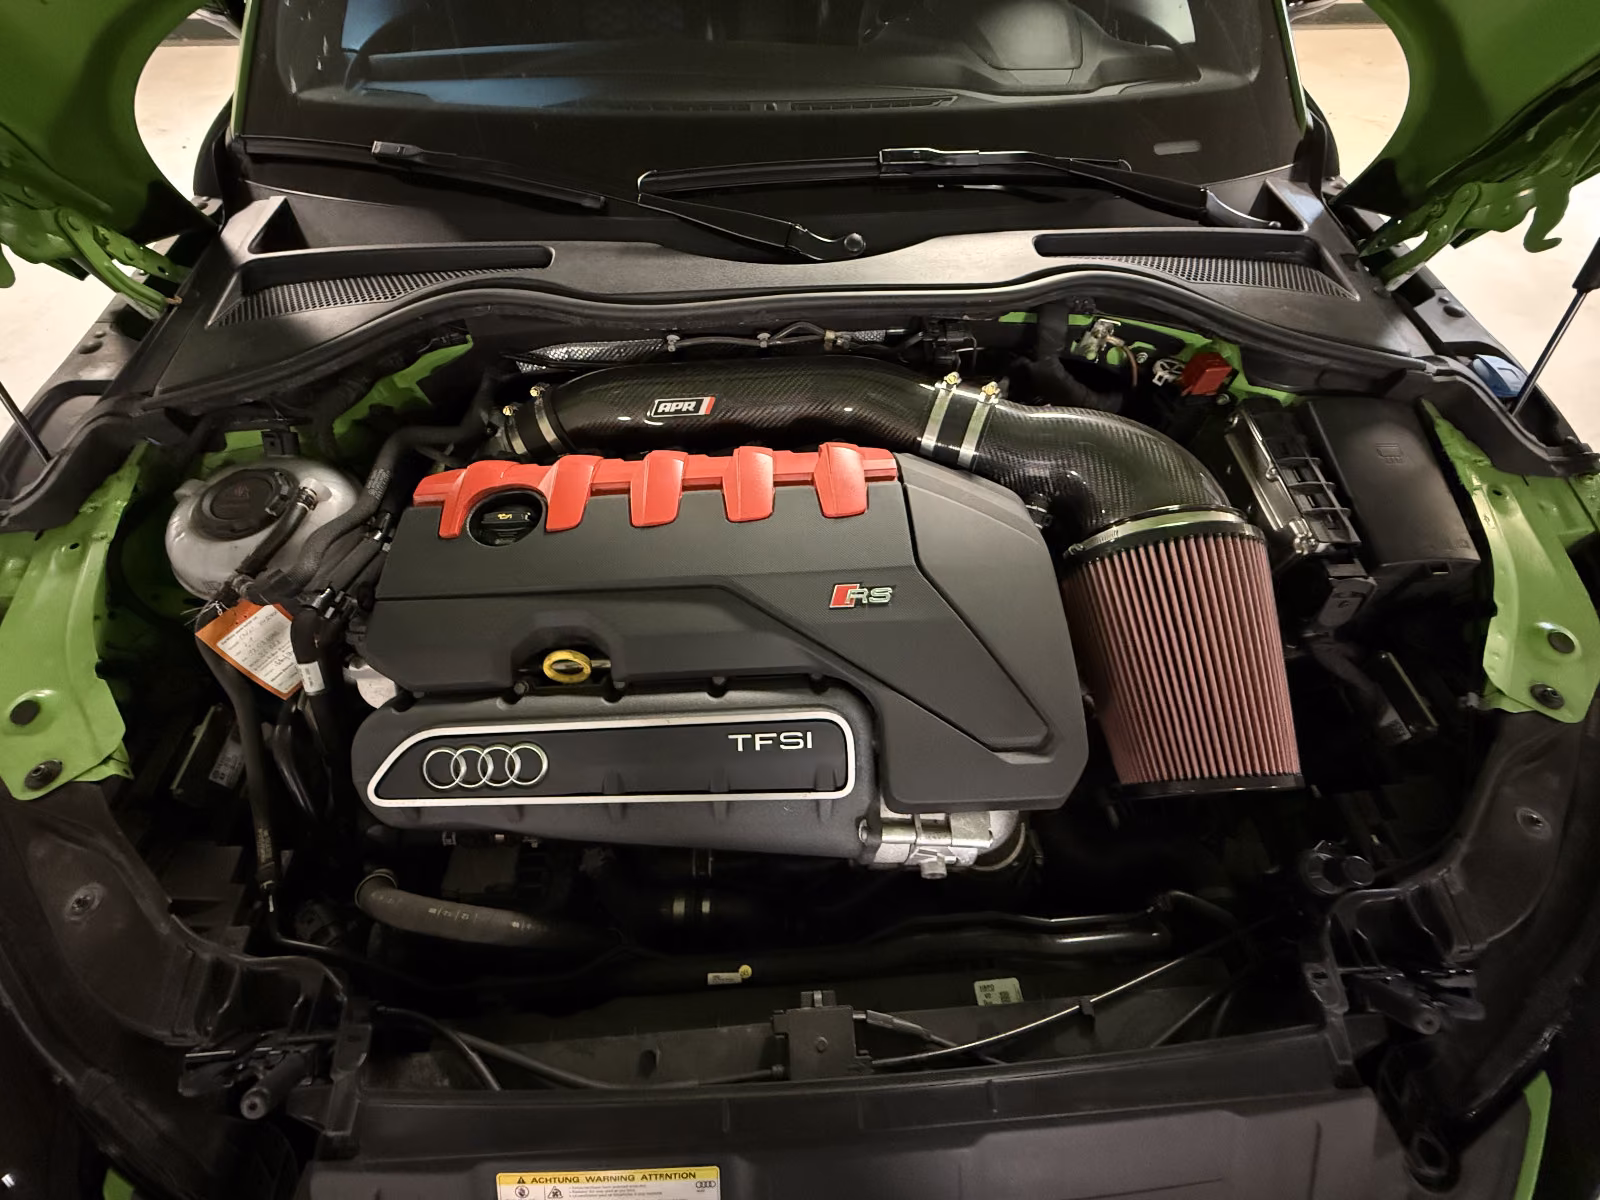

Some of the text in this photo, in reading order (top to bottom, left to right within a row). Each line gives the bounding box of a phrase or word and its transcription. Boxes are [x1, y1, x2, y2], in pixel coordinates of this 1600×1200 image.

[657, 401, 697, 413] APR
[843, 586, 893, 604] RS
[727, 731, 812, 752] TFSI
[530, 1171, 697, 1184] ACHTUNG WARNING ATTENTION
